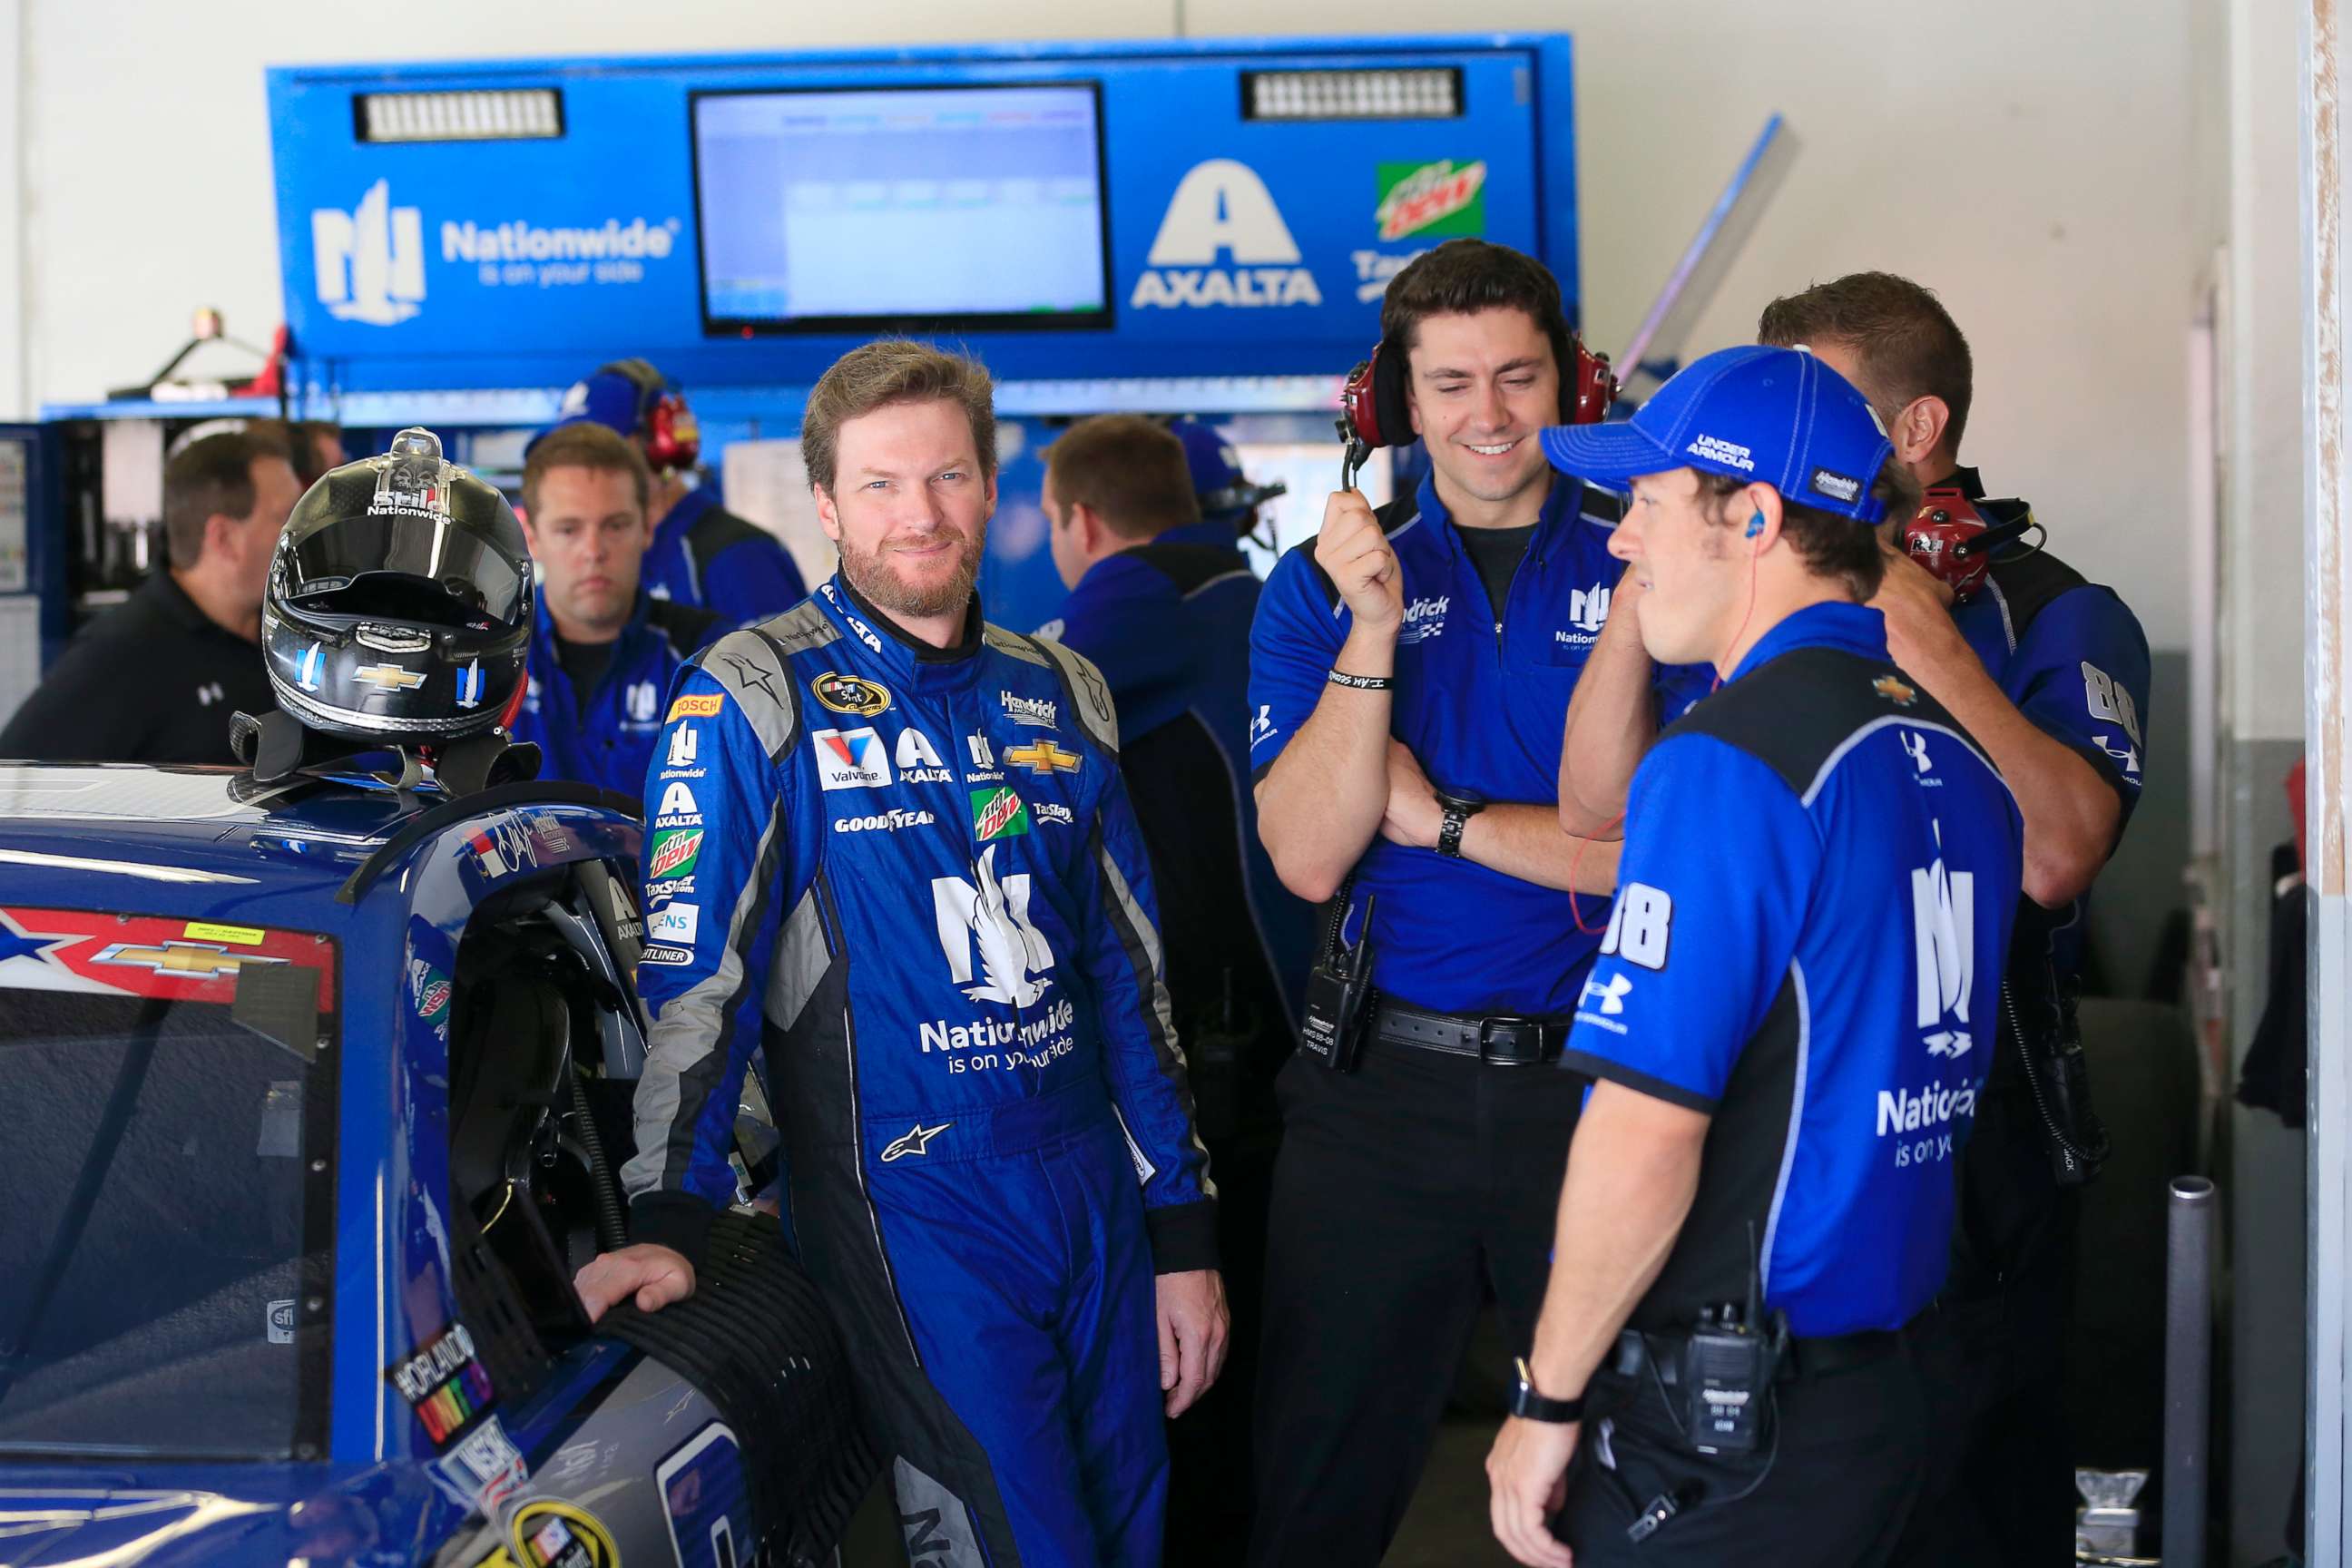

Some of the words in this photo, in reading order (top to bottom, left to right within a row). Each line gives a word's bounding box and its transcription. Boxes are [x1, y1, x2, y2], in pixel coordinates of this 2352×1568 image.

[1131, 269, 1323, 309] AXALTA
[1697, 433, 1751, 459] UNDER
[1686, 442, 1755, 472] ARMOUR
[367, 505, 452, 525] Nationwide
[1555, 631, 1599, 644] Nation
[659, 769, 703, 780] ationwide
[655, 814, 703, 829] AXALTA
[948, 1056, 965, 1074] is
[971, 1054, 998, 1070] on
[1895, 1140, 1911, 1169] is
